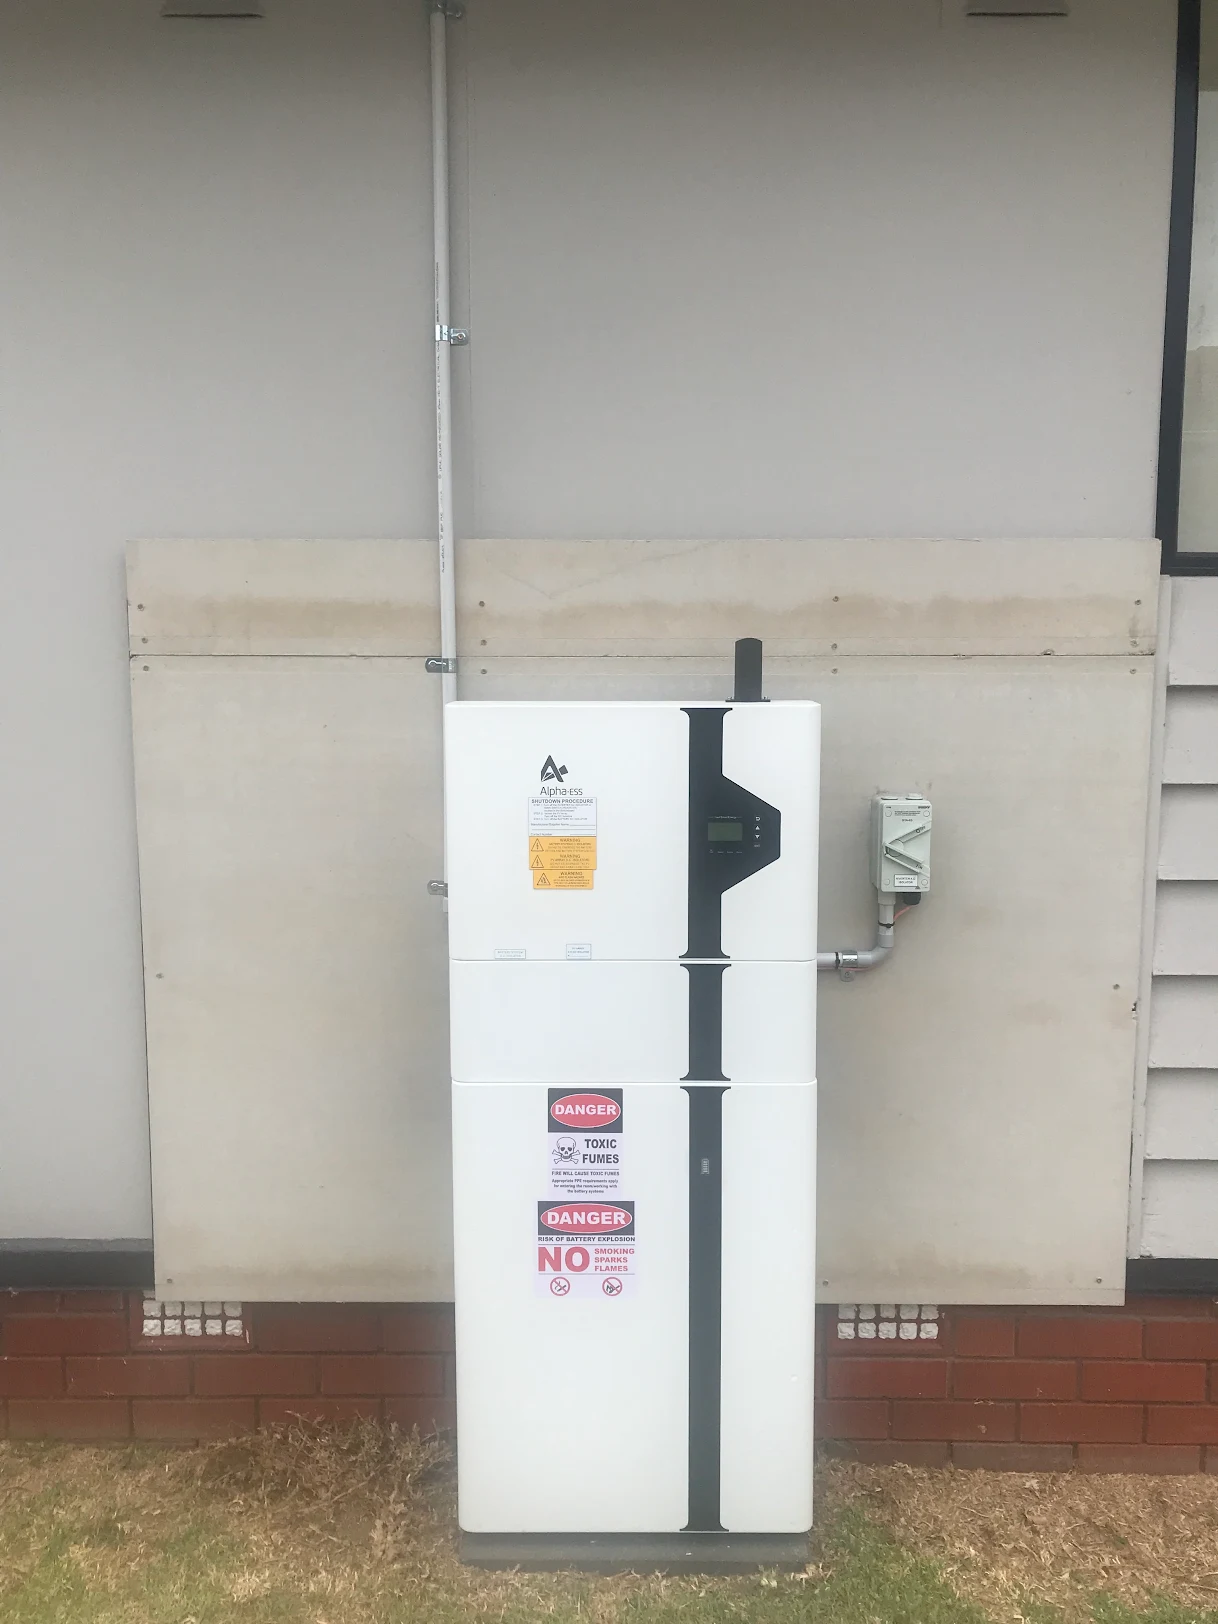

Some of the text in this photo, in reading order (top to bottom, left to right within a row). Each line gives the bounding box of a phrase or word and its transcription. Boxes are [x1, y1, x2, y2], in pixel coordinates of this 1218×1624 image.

[555, 1104, 616, 1115] DANGER
[584, 1138, 617, 1148] TOXIC
[582, 1154, 619, 1164] FUMES
[547, 1212, 626, 1224] DANGER
[538, 1246, 590, 1272] NO
